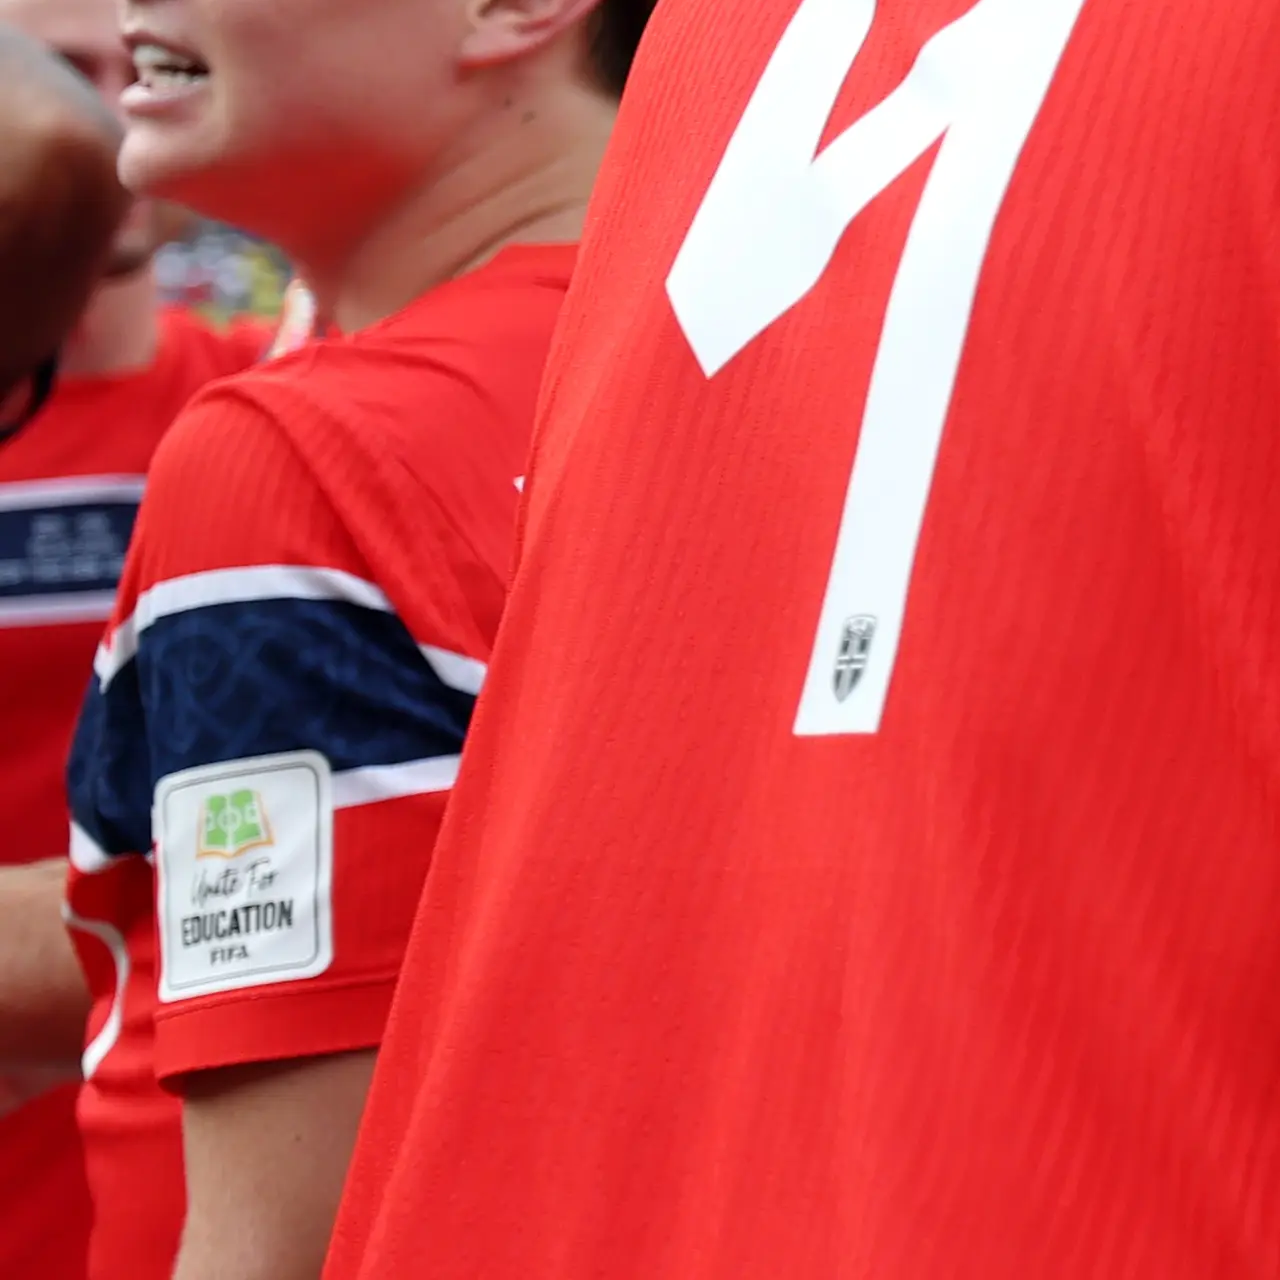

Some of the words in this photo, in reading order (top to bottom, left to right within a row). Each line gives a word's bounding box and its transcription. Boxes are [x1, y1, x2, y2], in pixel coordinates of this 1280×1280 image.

[191, 868, 239, 906] Unite
[180, 899, 294, 948] EDUCATION
[210, 944, 249, 966] FIFA
